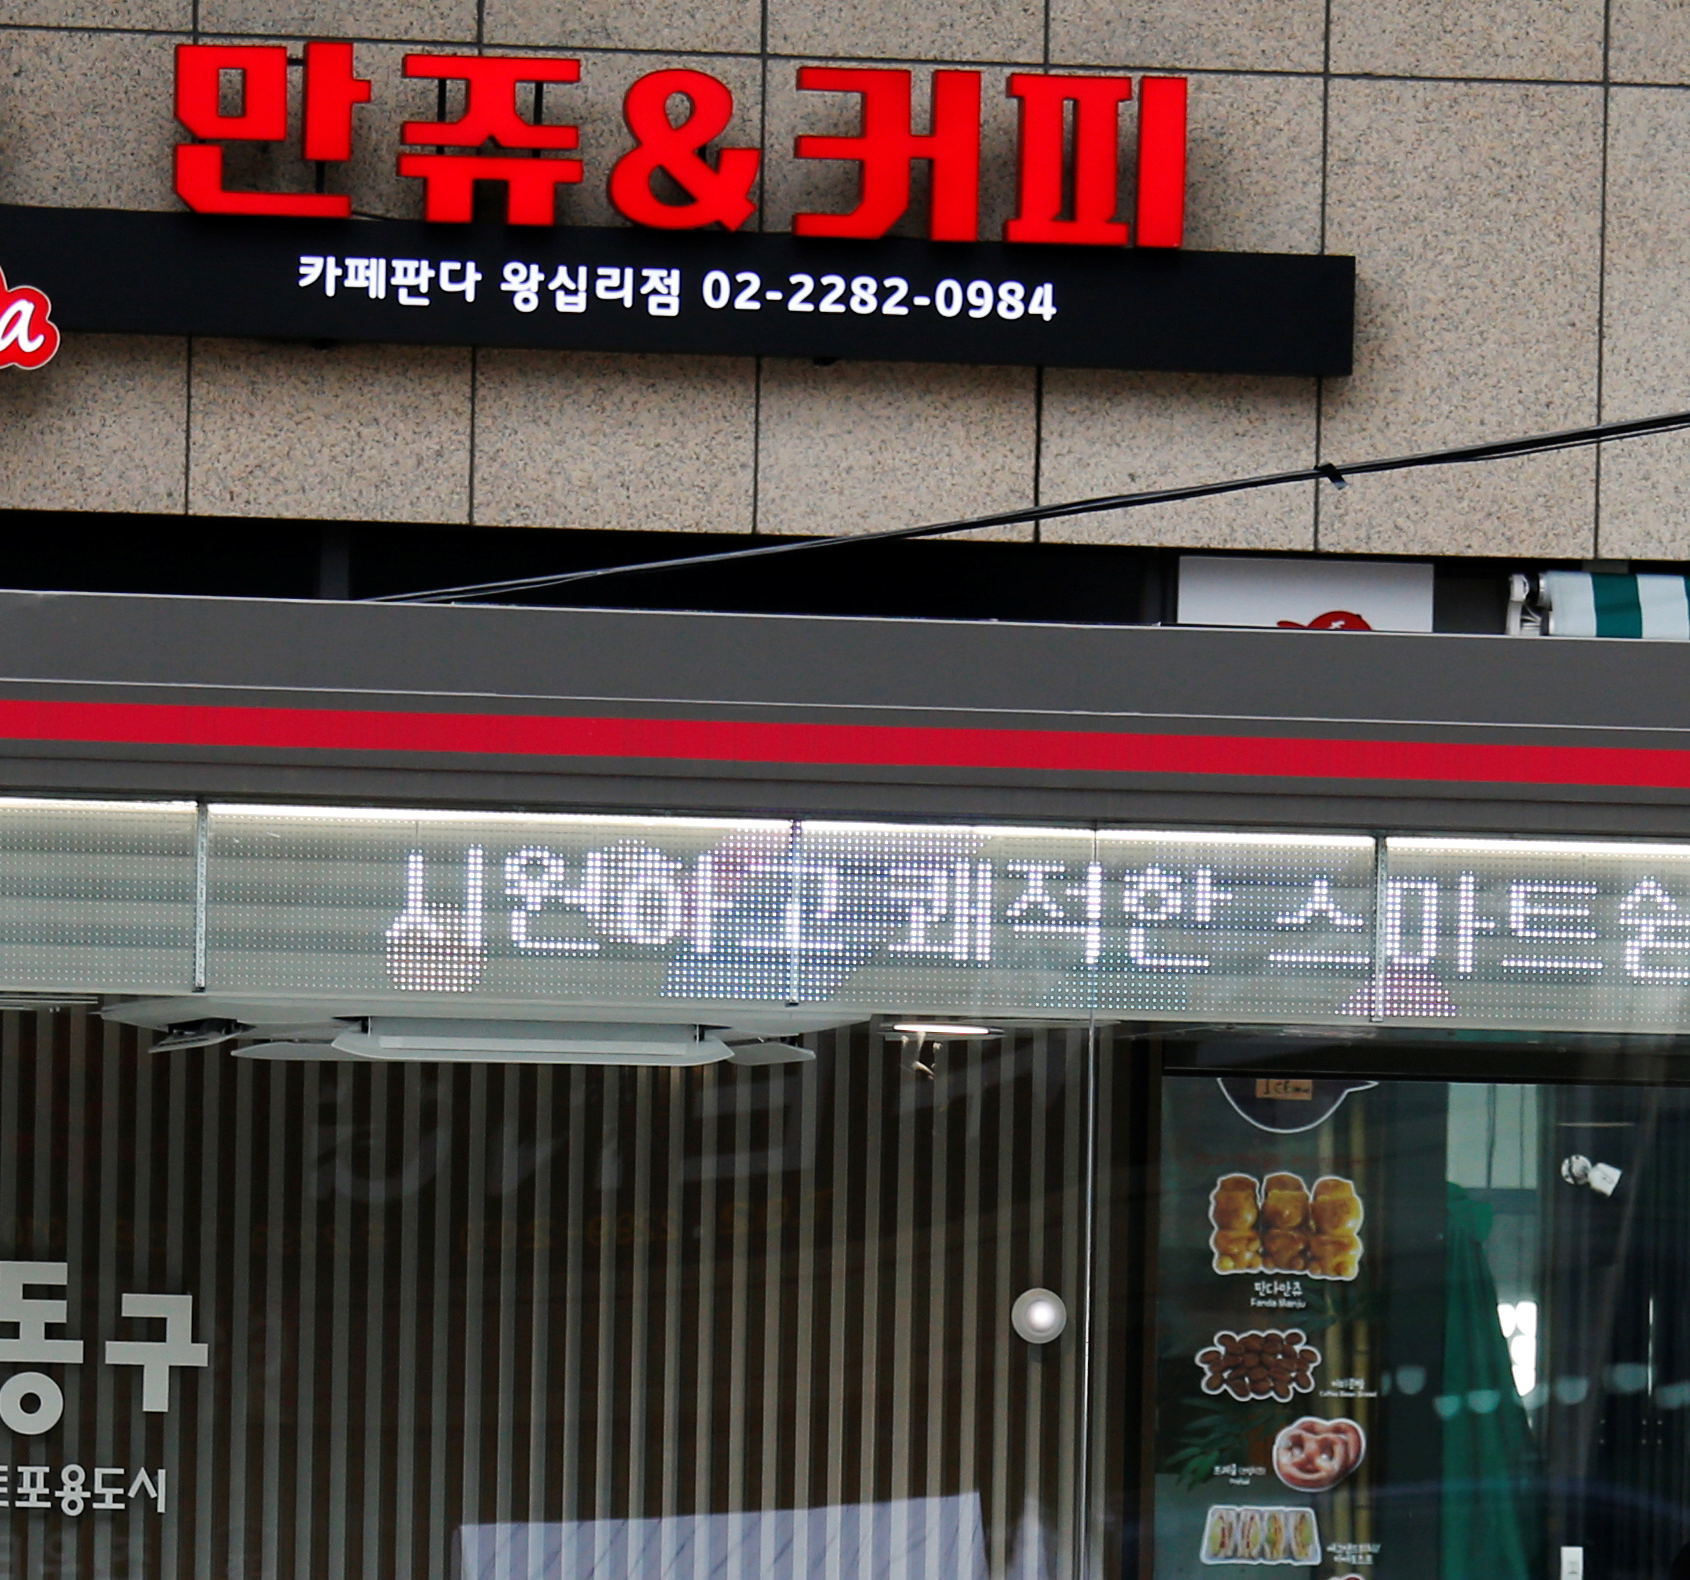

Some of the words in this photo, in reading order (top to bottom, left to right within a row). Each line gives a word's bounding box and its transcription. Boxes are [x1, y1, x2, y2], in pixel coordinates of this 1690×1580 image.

[172, 40, 1190, 249] 만쥬&커피
[298, 253, 485, 306] 카페판다
[500, 258, 685, 318] 왕십리점
[702, 276, 1060, 323] 02-2282-0984
[384, 843, 850, 962] 시원하고
[886, 854, 1238, 972] 쾌적한
